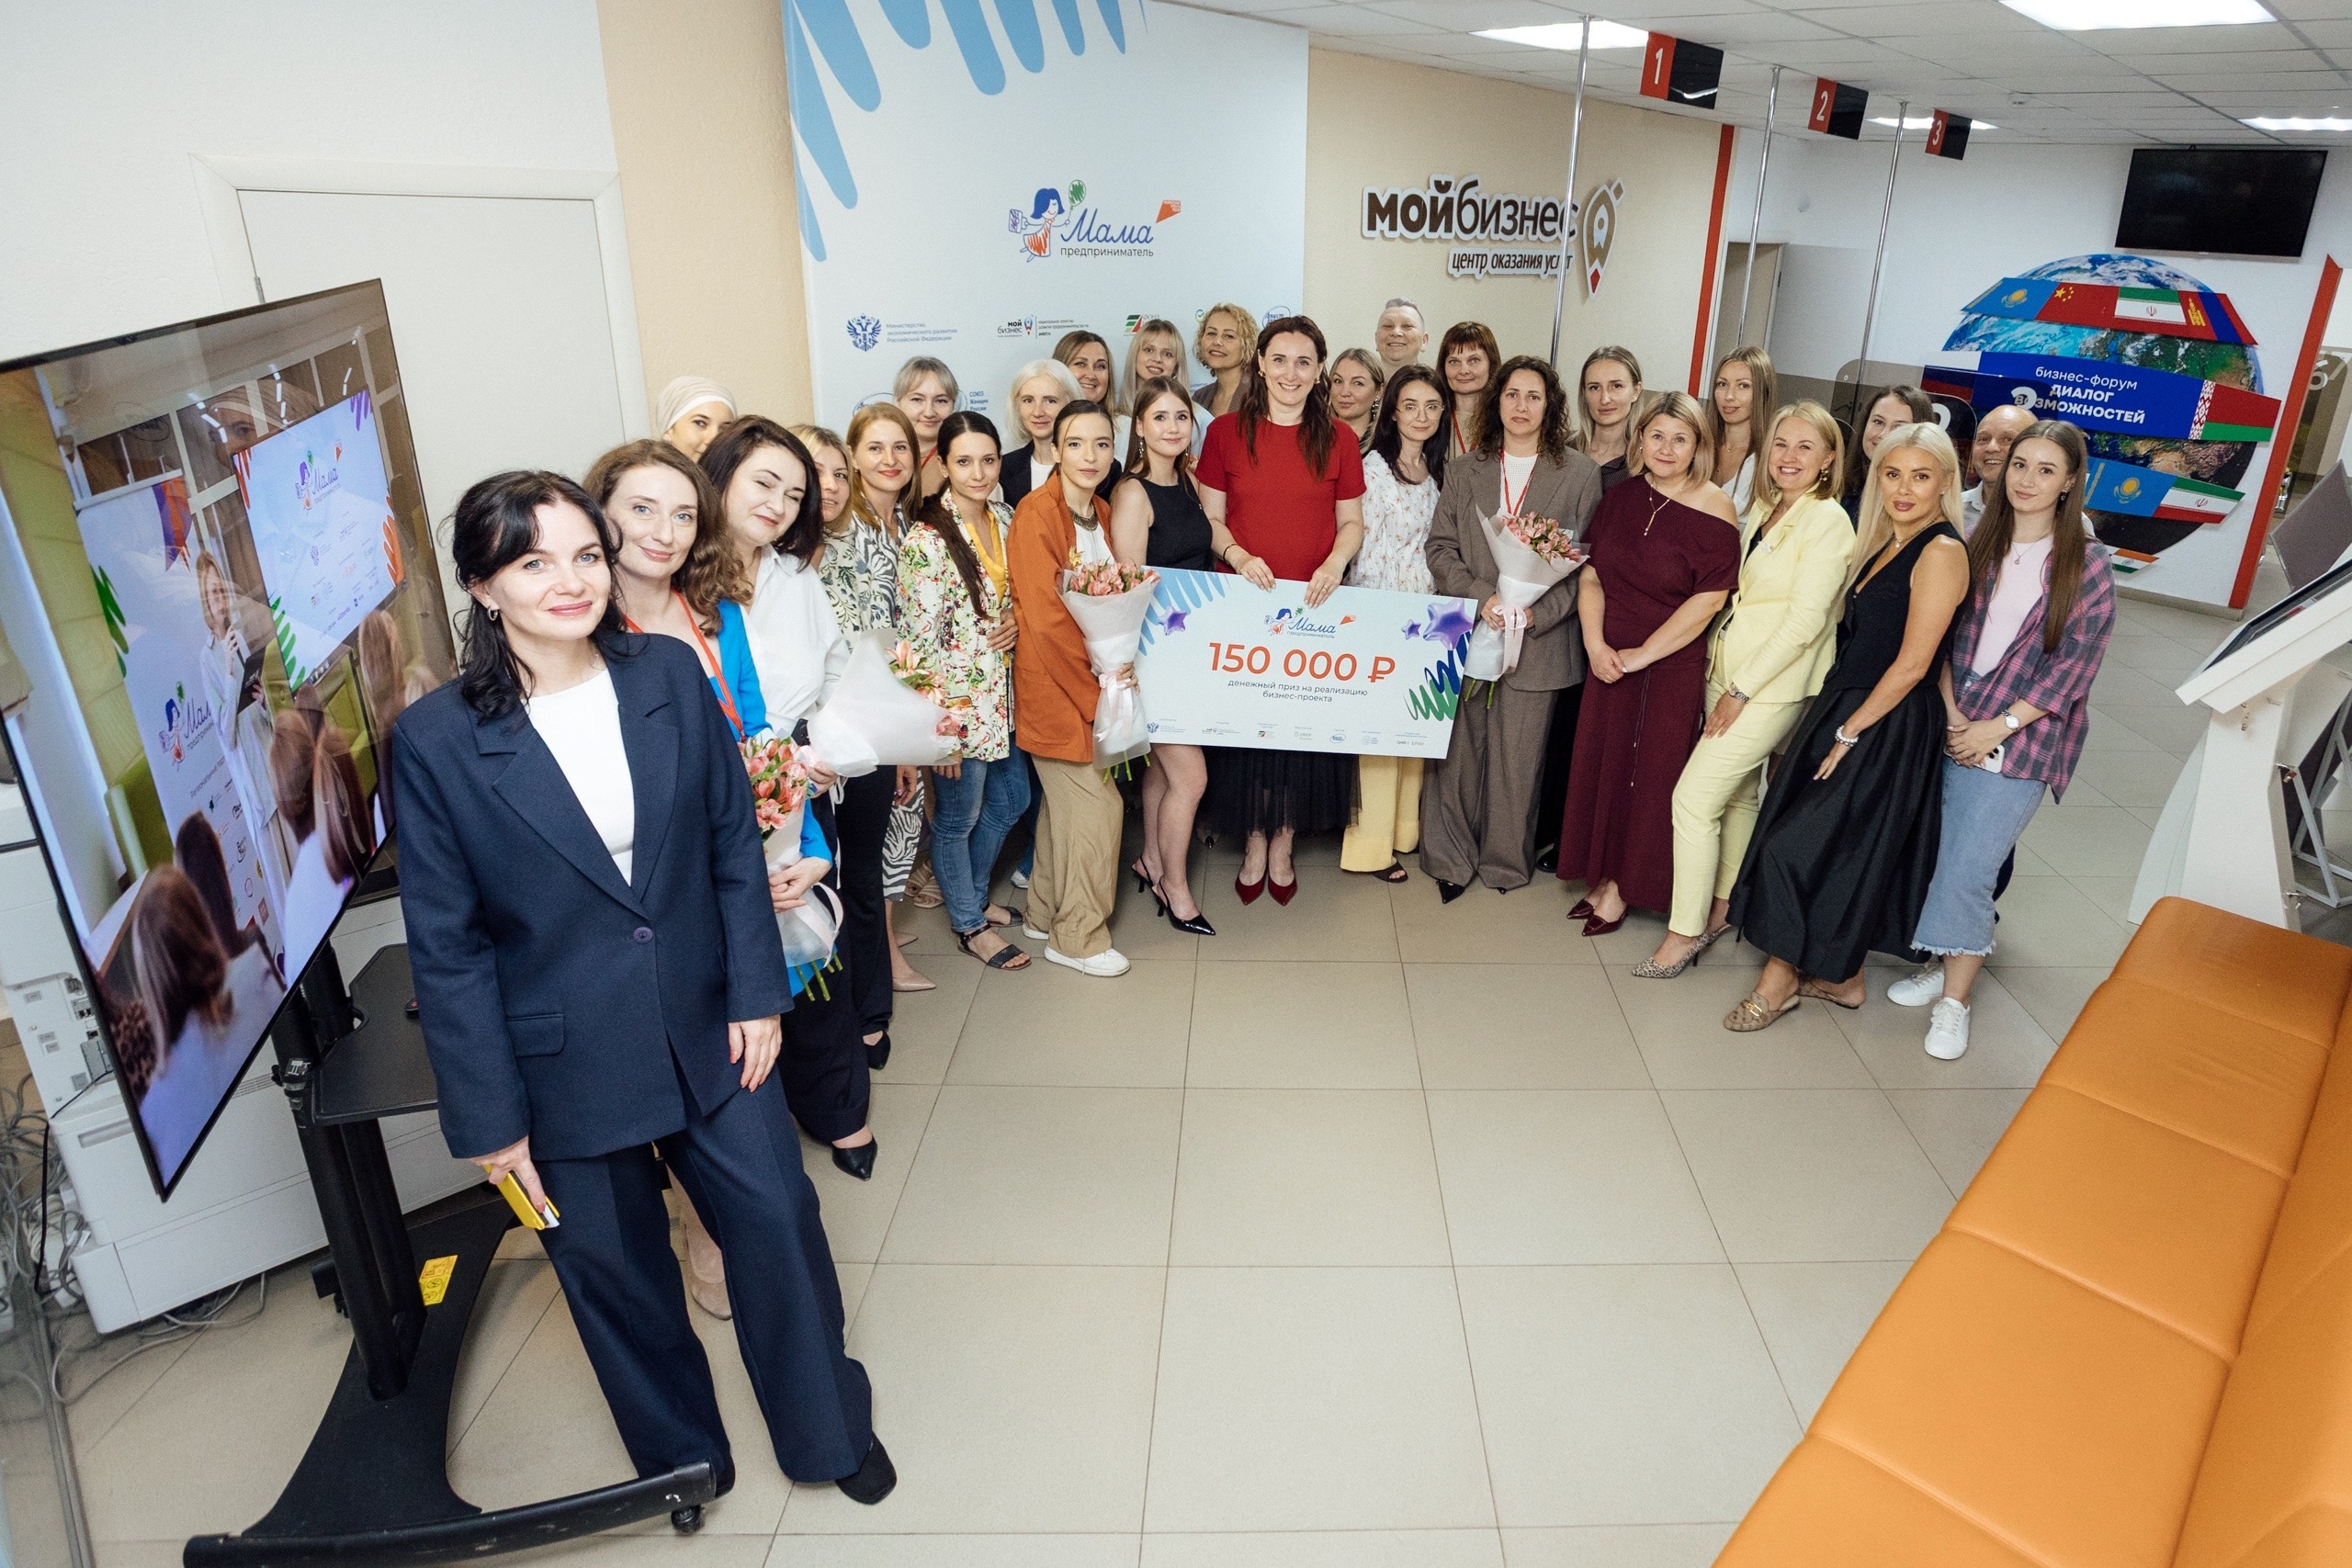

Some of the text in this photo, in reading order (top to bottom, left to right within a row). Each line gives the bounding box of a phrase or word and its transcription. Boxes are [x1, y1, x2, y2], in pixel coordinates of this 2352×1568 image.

[1654, 48, 1664, 85] 1
[1816, 91, 1828, 121] 2
[1932, 119, 1942, 145] 3
[1060, 208, 1154, 243] Мама
[1060, 247, 1154, 258] предприниматель
[1453, 253, 1572, 278] центр оказания услг
[2035, 367, 2138, 390] бизнес-форум
[2050, 384, 2114, 403] ДИАЛОГ
[1287, 631, 1335, 639] предприниматель
[1288, 617, 1336, 634] Мама
[1209, 642, 1271, 674] 150
[1283, 649, 1357, 681] 000
[1228, 680, 1276, 689] денежный
[1278, 683, 1300, 692] приз
[1314, 687, 1368, 696] реализацию
[1262, 690, 1332, 703] бизнес-проекта
